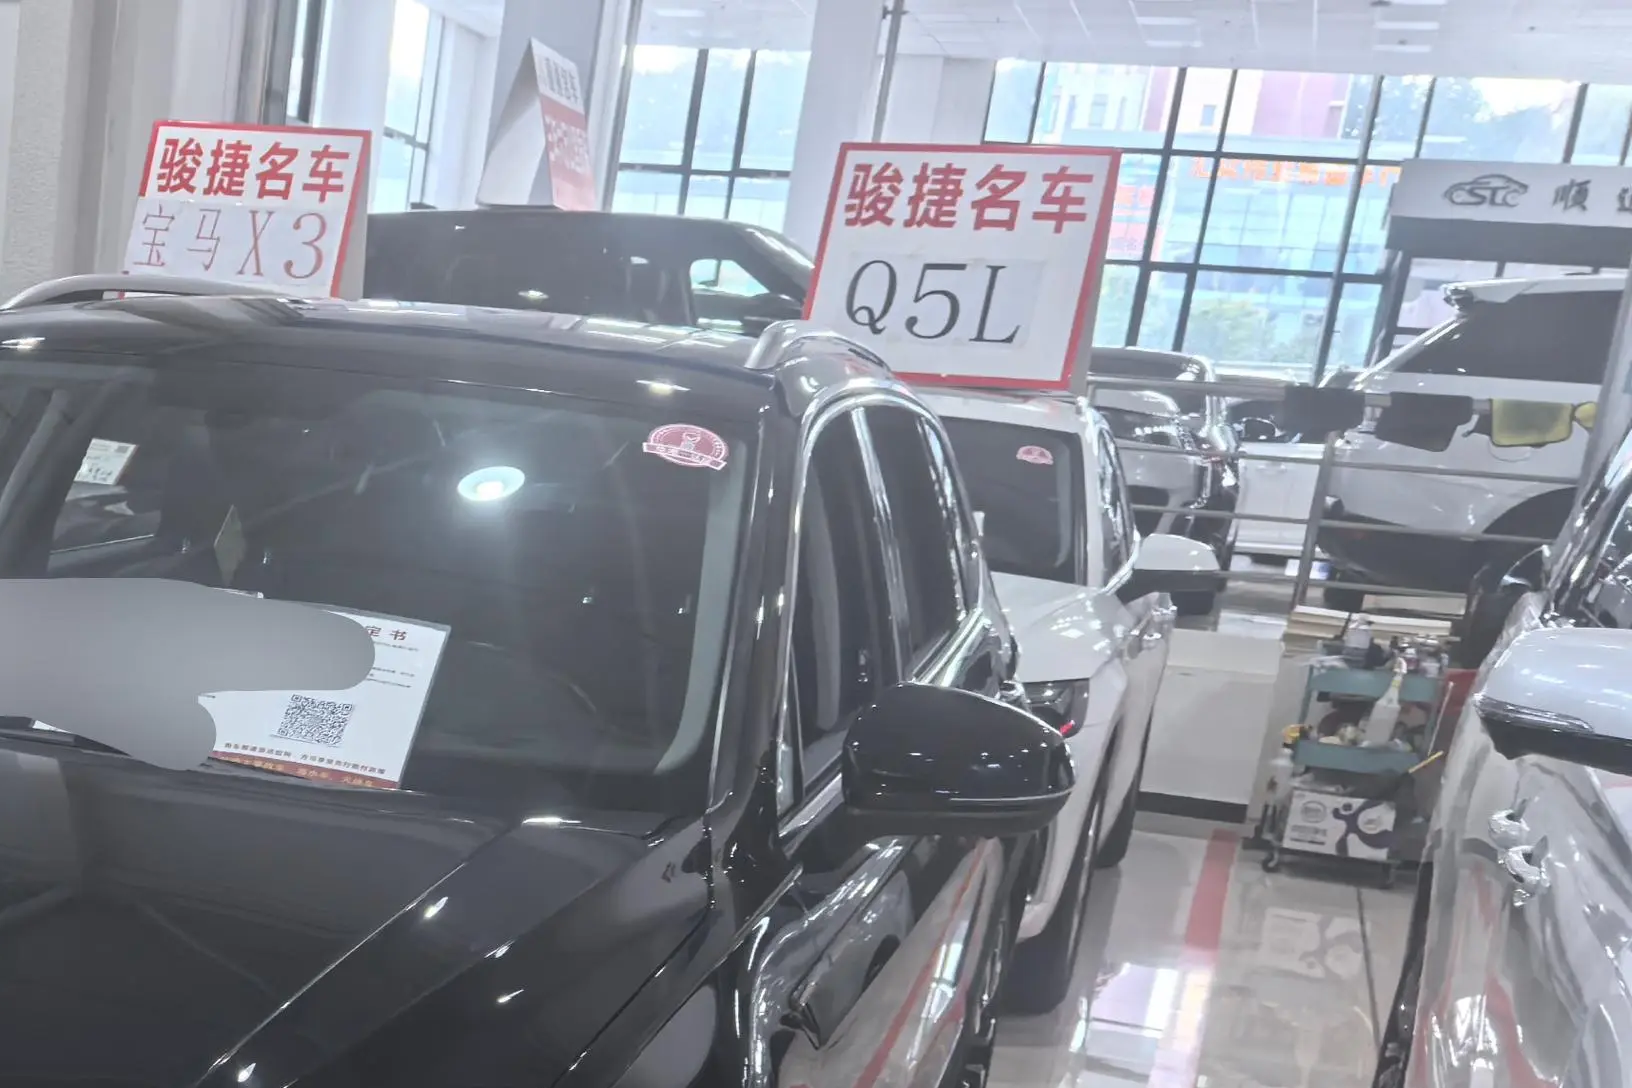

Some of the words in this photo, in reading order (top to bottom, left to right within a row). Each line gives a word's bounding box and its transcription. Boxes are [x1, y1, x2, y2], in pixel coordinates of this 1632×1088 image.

[156, 137, 350, 204] 骏捷名车
[843, 161, 1095, 235] 骏捷名车
[132, 203, 328, 280] 宝马X3
[844, 259, 1022, 345] Q5L
